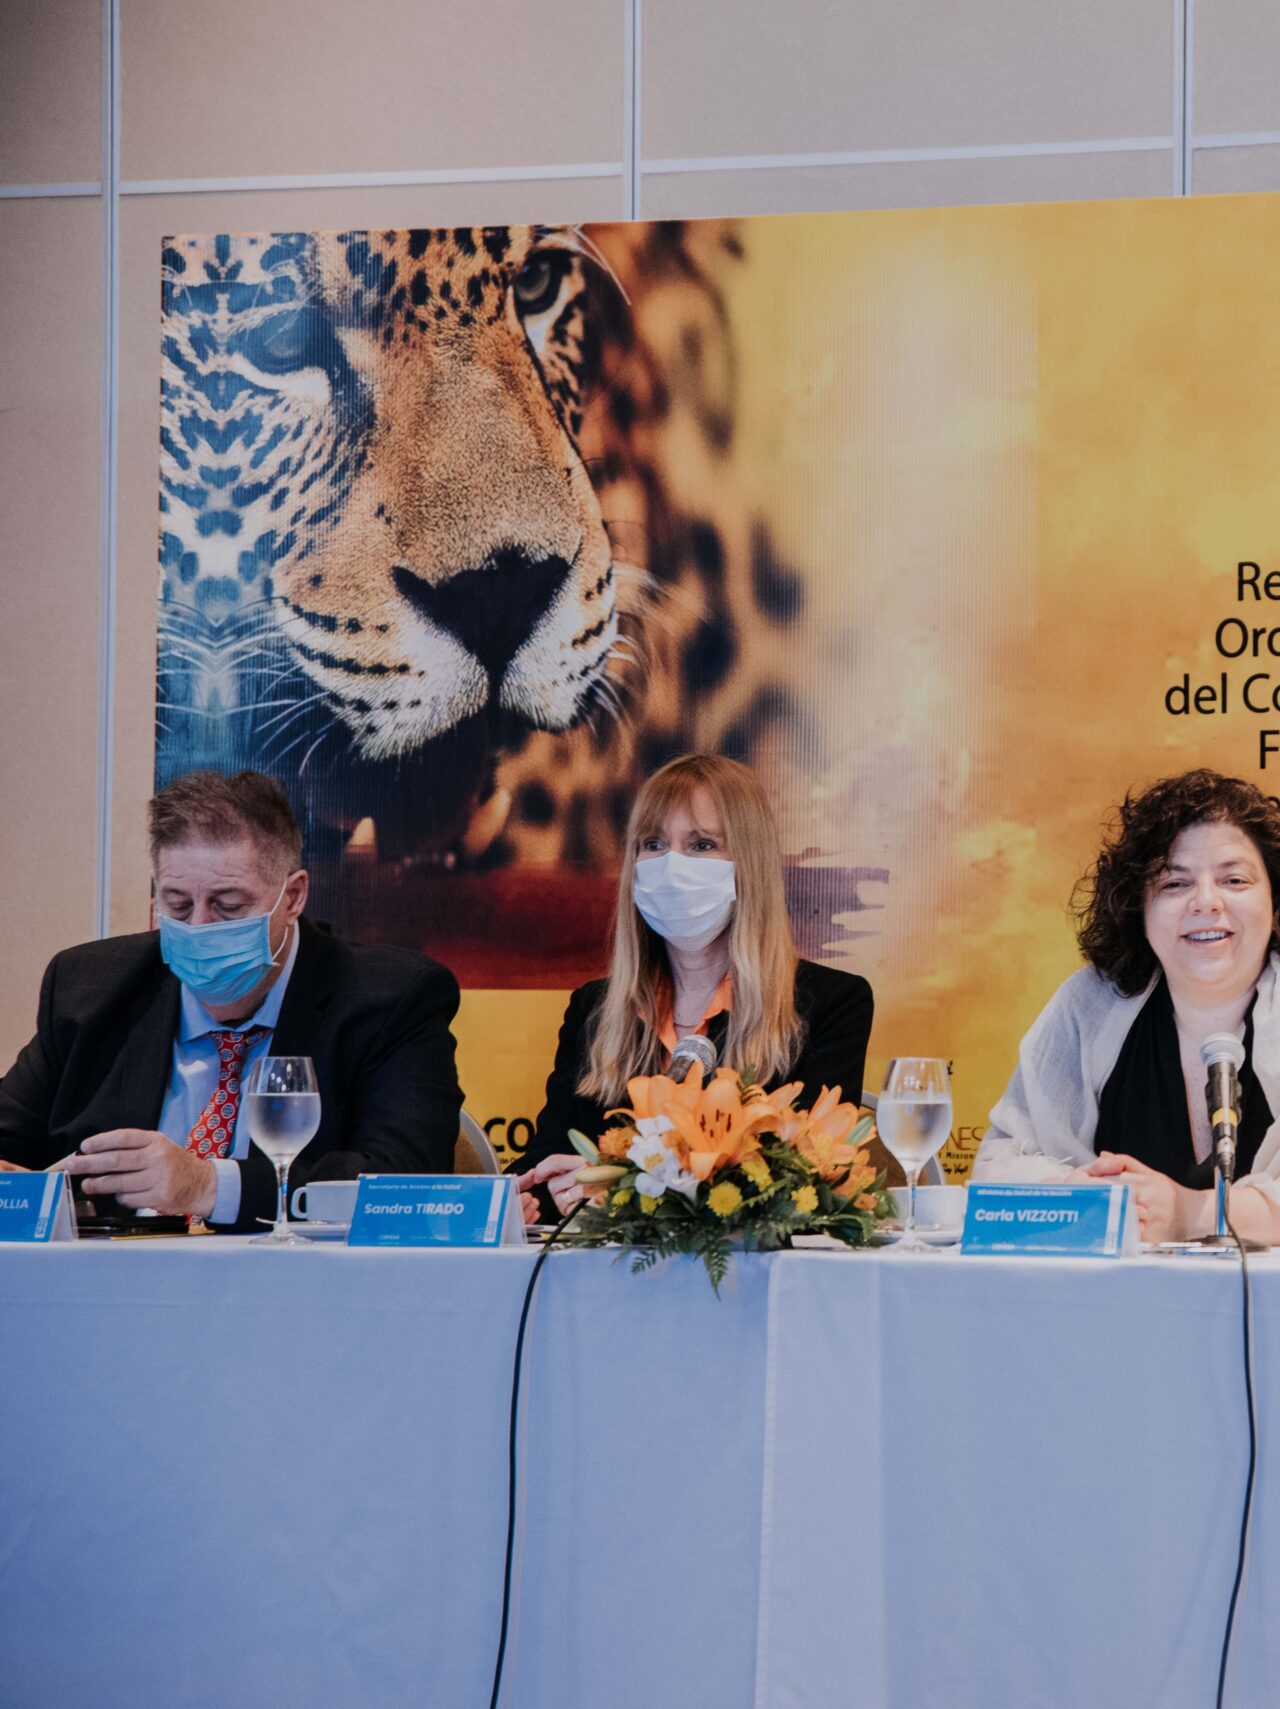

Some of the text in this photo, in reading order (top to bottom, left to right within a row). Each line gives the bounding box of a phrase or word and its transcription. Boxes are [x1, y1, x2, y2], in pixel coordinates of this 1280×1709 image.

[1164, 672, 1228, 716] del
[365, 1203, 464, 1214] Sandra TIRADO
[975, 1209, 1078, 1222] Carla VIZZOTTI
